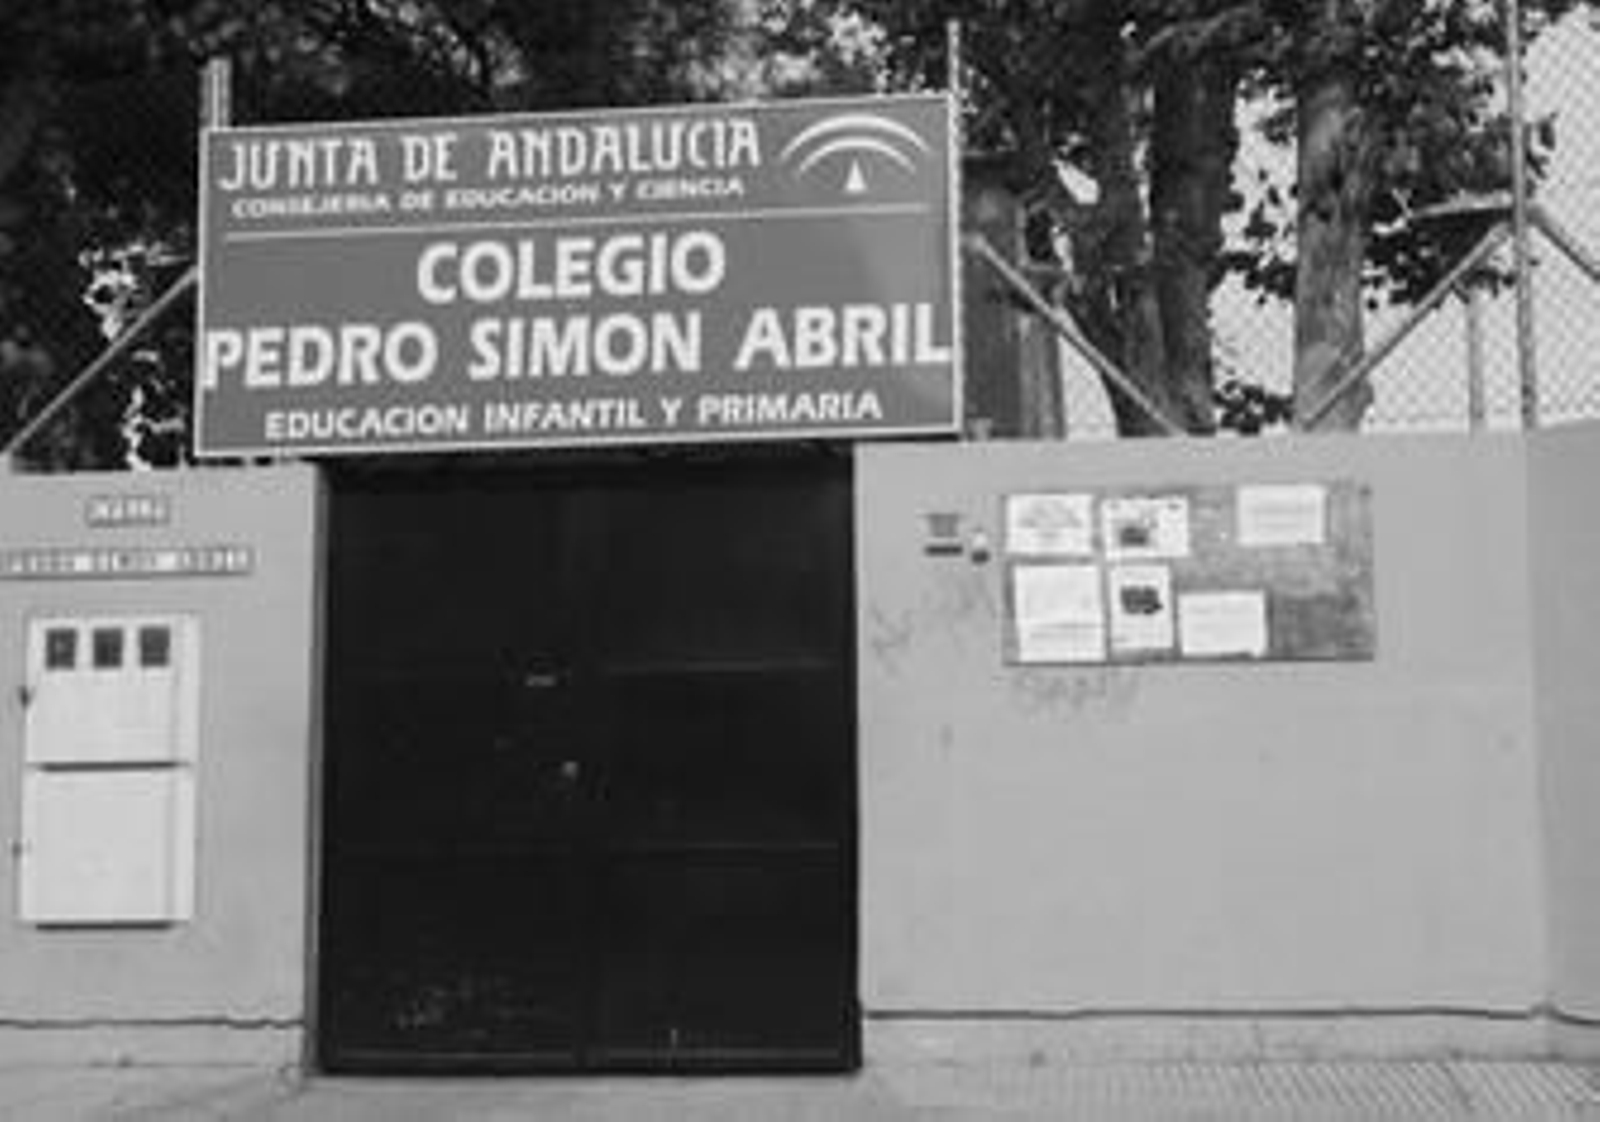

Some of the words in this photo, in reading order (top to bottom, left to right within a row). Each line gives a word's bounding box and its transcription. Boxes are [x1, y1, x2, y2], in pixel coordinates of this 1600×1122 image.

[219, 138, 377, 190] JUNTA
[402, 132, 458, 181] DE
[488, 119, 761, 180] ANDALUCIA
[400, 187, 433, 210] DE
[608, 180, 626, 200] Y
[637, 177, 744, 201] CIENCIA
[417, 231, 726, 304] COLEGIO
[203, 321, 438, 390] PEDRO
[469, 310, 701, 381] SIMON
[733, 302, 952, 370] ABRIL
[264, 403, 469, 440] EDUCACION
[484, 397, 646, 433] INFANTIL
[660, 396, 682, 427] Y
[699, 389, 882, 425] PRIMARIA
